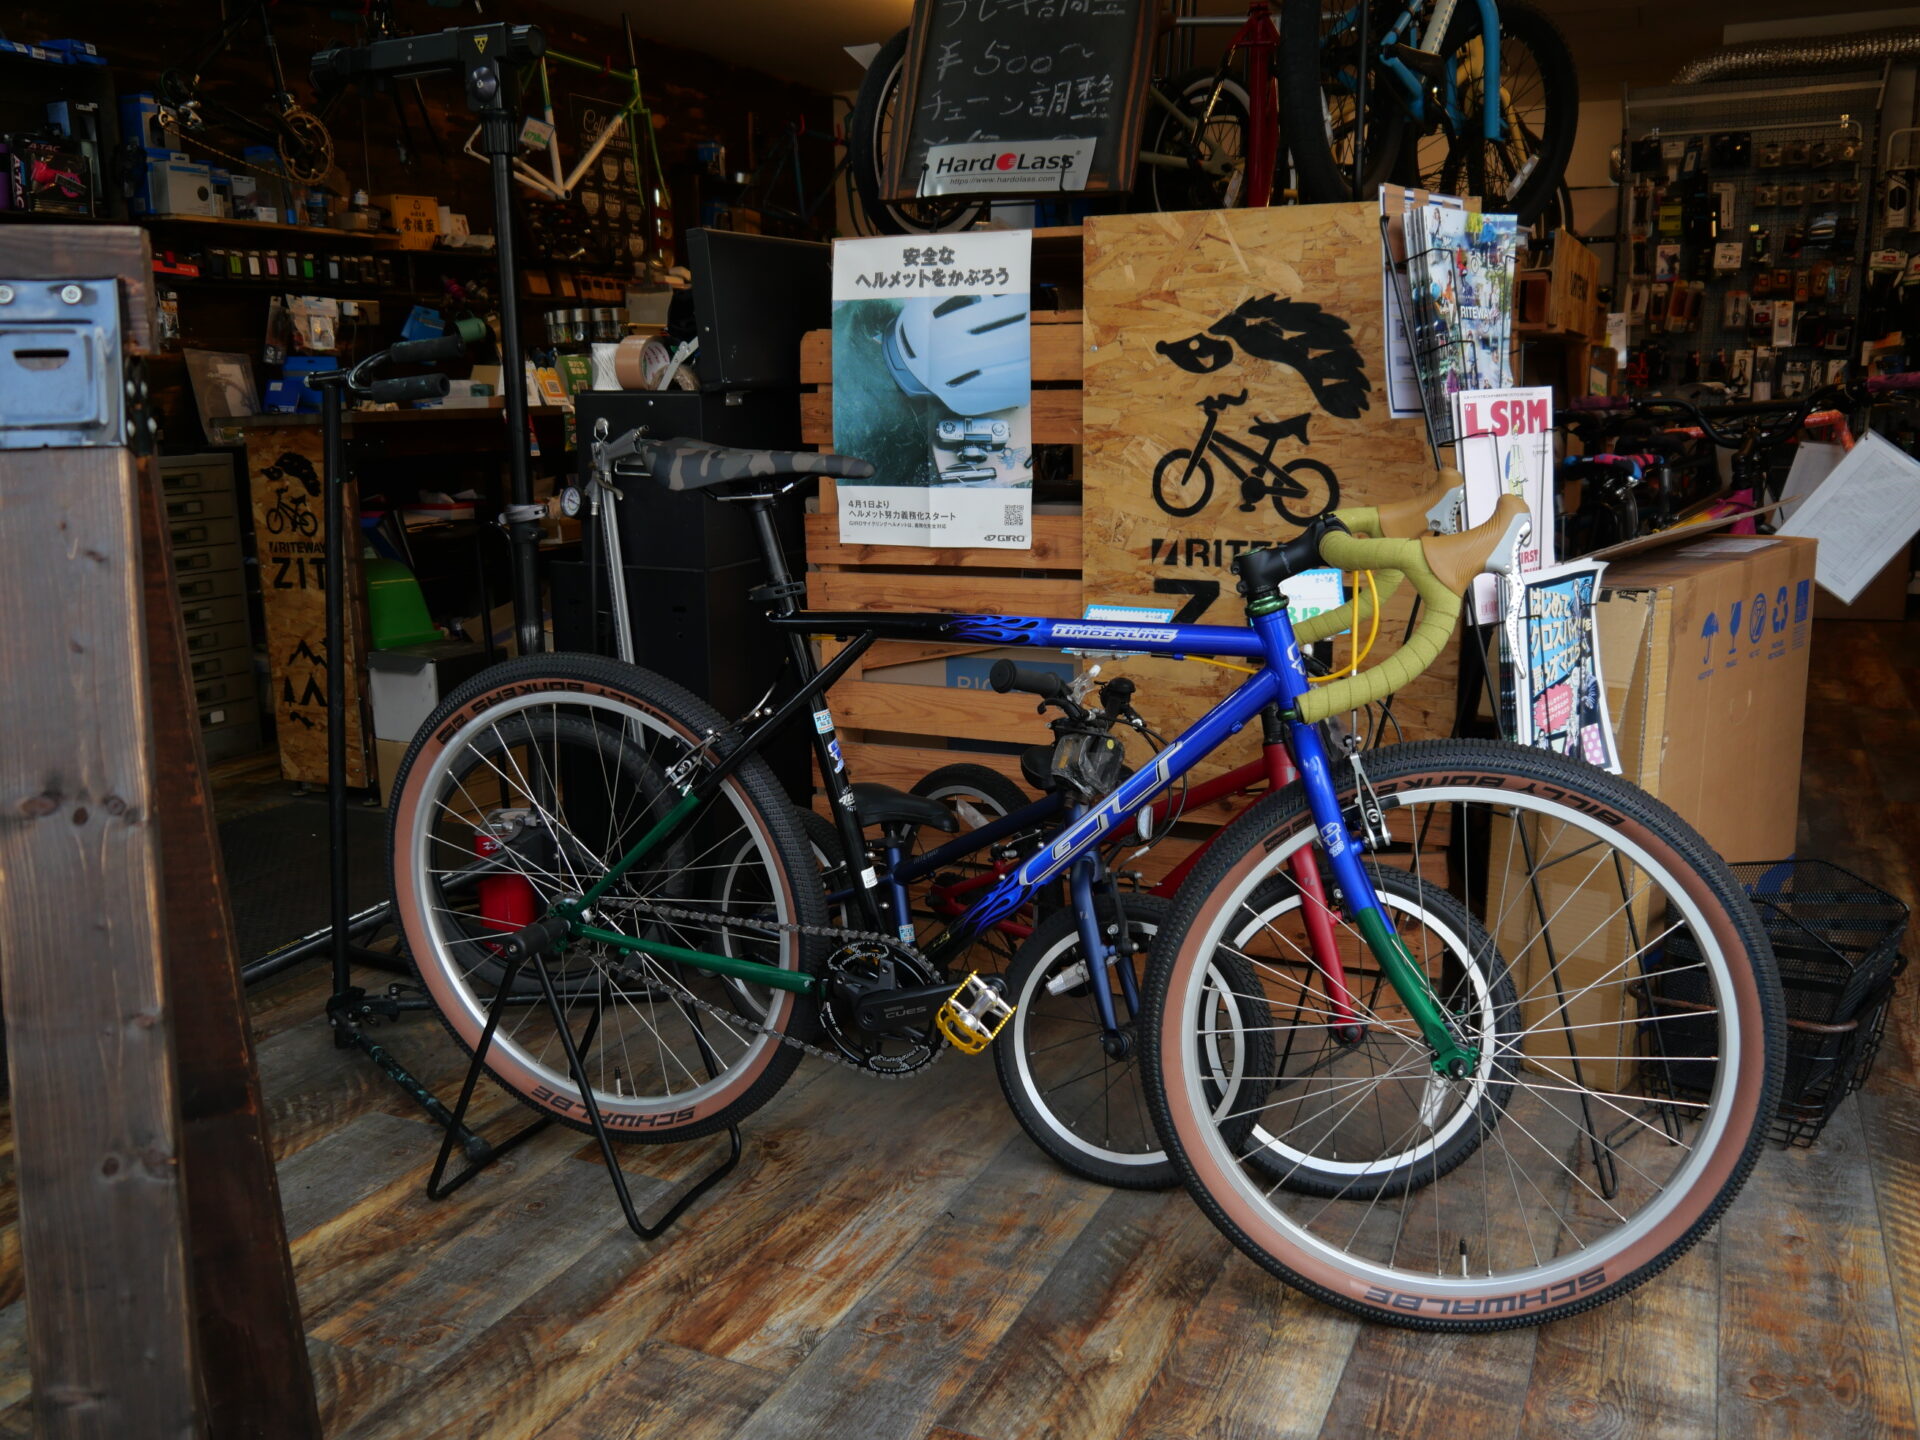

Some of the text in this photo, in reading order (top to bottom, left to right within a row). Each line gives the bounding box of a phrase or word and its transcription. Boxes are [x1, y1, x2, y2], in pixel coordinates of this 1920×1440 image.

[921, 74, 1114, 121] チェーン調整
[903, 246, 956, 267] 安全な
[855, 267, 1010, 289] ヘルメットをかぶろう
[848, 500, 890, 509] 4月1日より
[848, 509, 957, 521] ヘルメット努力義務化スタート
[997, 534, 1026, 543] GIRO
[1364, 1267, 1607, 1315] SCHWALBE
